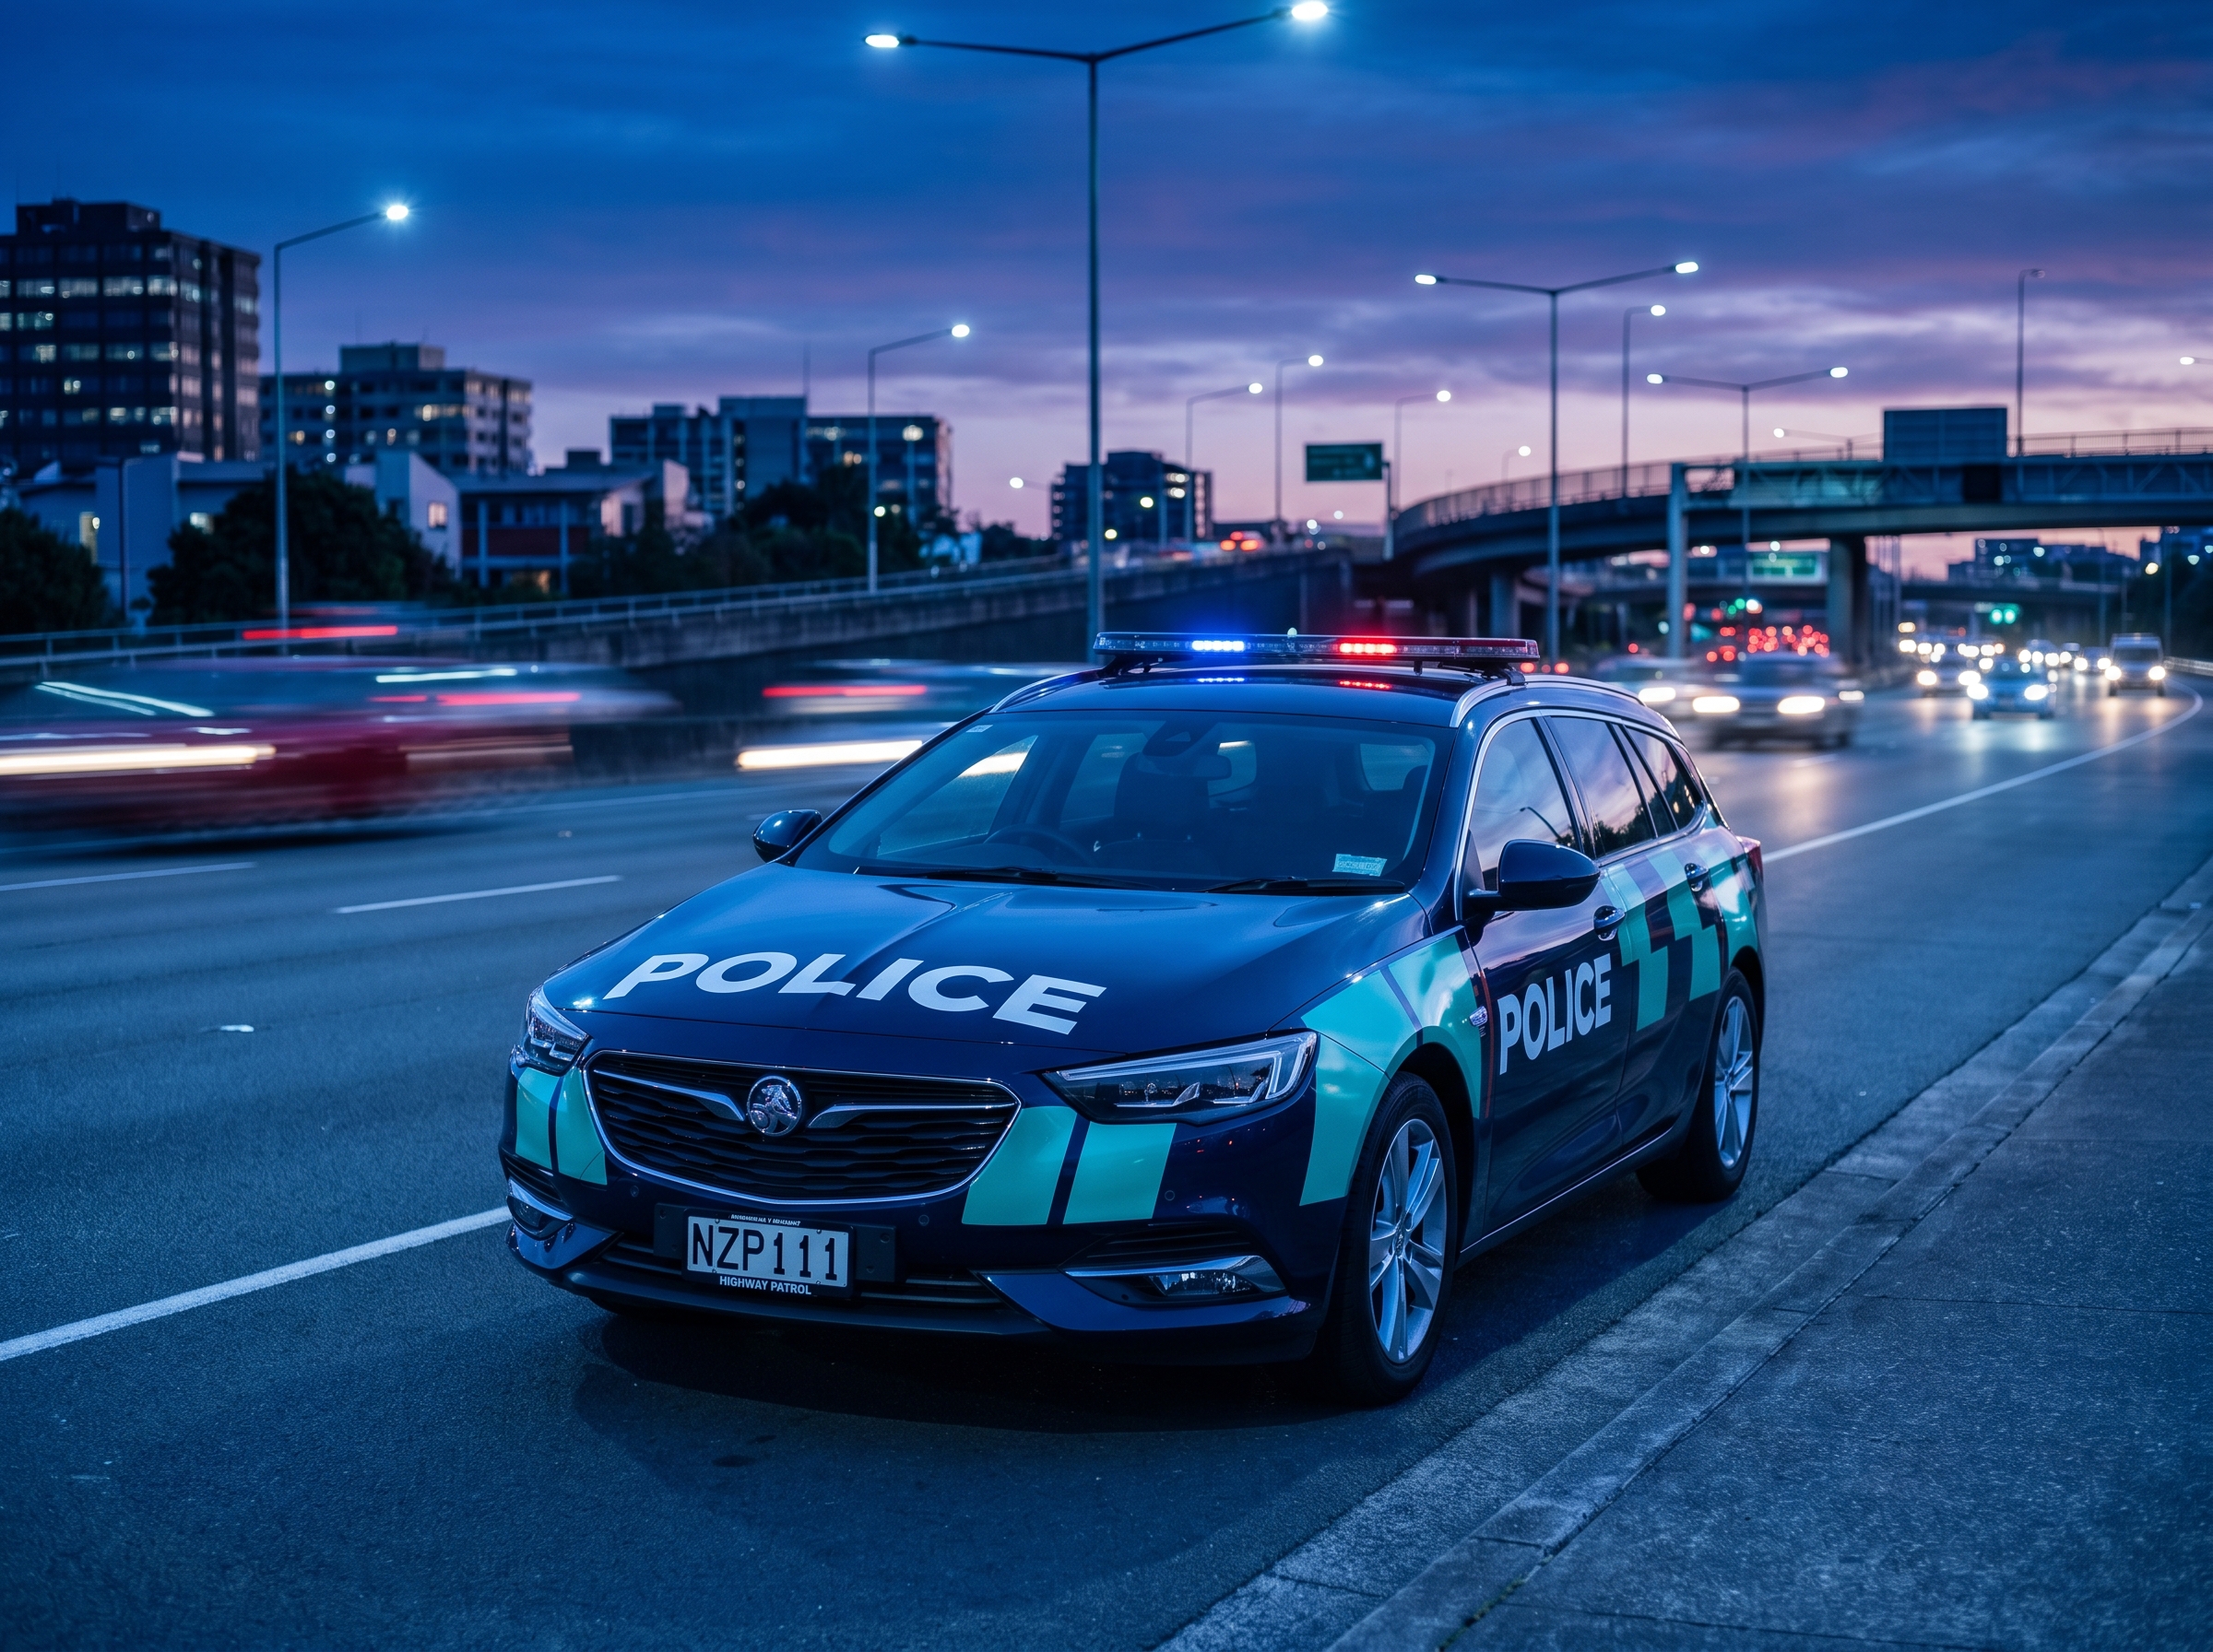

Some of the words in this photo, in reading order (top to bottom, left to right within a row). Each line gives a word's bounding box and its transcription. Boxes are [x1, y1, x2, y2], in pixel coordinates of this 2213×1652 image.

[602, 951, 1106, 1035] POLICE
[1498, 954, 1611, 1075] POLICE
[692, 1223, 837, 1280] NZP111
[720, 1276, 768, 1290] HIGHWAY
[771, 1282, 811, 1294] PATROL
